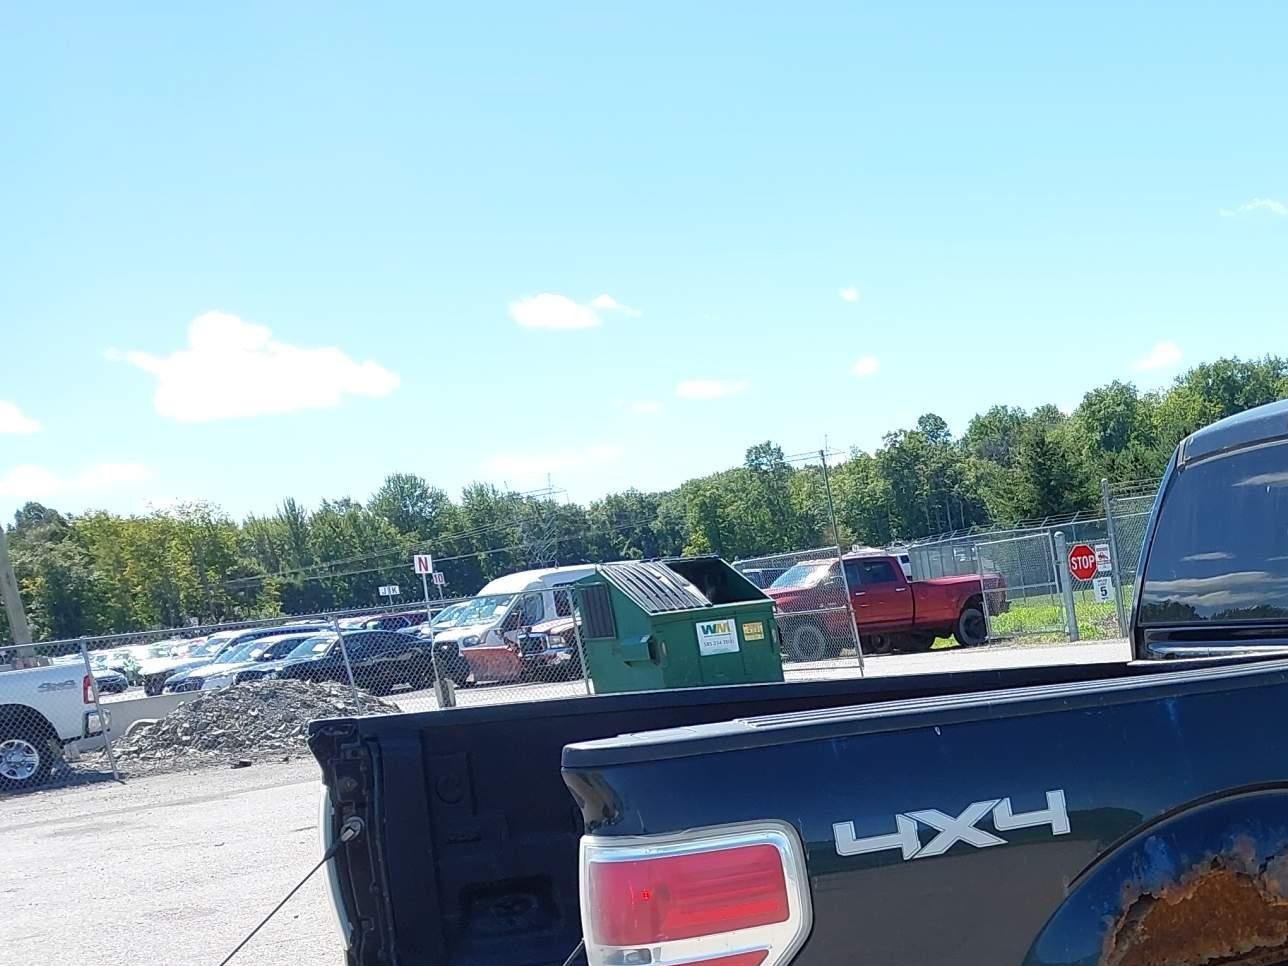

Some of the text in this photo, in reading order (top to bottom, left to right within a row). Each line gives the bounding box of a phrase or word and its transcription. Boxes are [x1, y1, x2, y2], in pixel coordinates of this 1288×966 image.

[418, 557, 429, 572] N
[1071, 555, 1095, 570] STOP
[434, 574, 443, 584] 10
[1100, 586, 1108, 597] 5
[701, 623, 731, 635] WM
